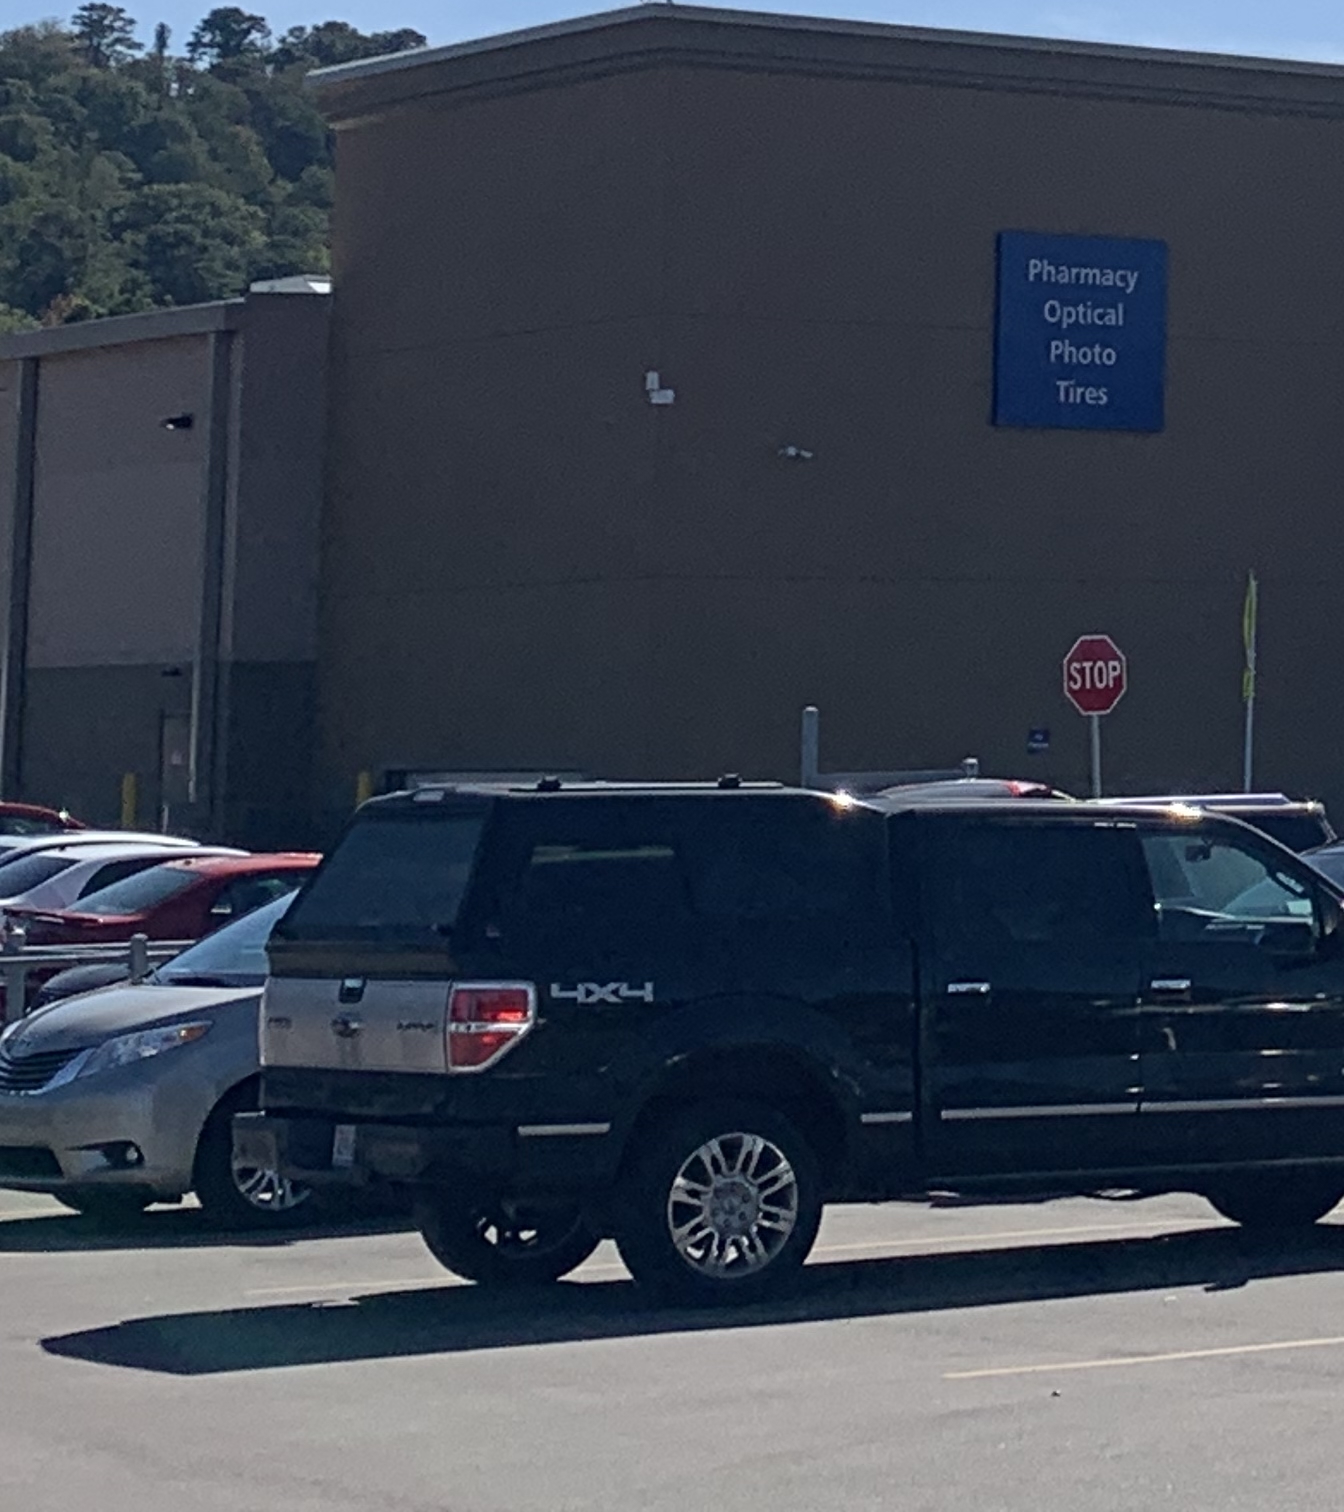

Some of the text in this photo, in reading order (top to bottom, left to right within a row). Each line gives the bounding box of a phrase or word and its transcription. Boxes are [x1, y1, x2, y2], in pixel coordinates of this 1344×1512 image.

[1028, 258, 1139, 294] Pharmacy
[1044, 299, 1124, 328] Optical
[1050, 339, 1117, 365] Photo
[1056, 380, 1109, 404] Tires
[1069, 660, 1121, 690] STOP
